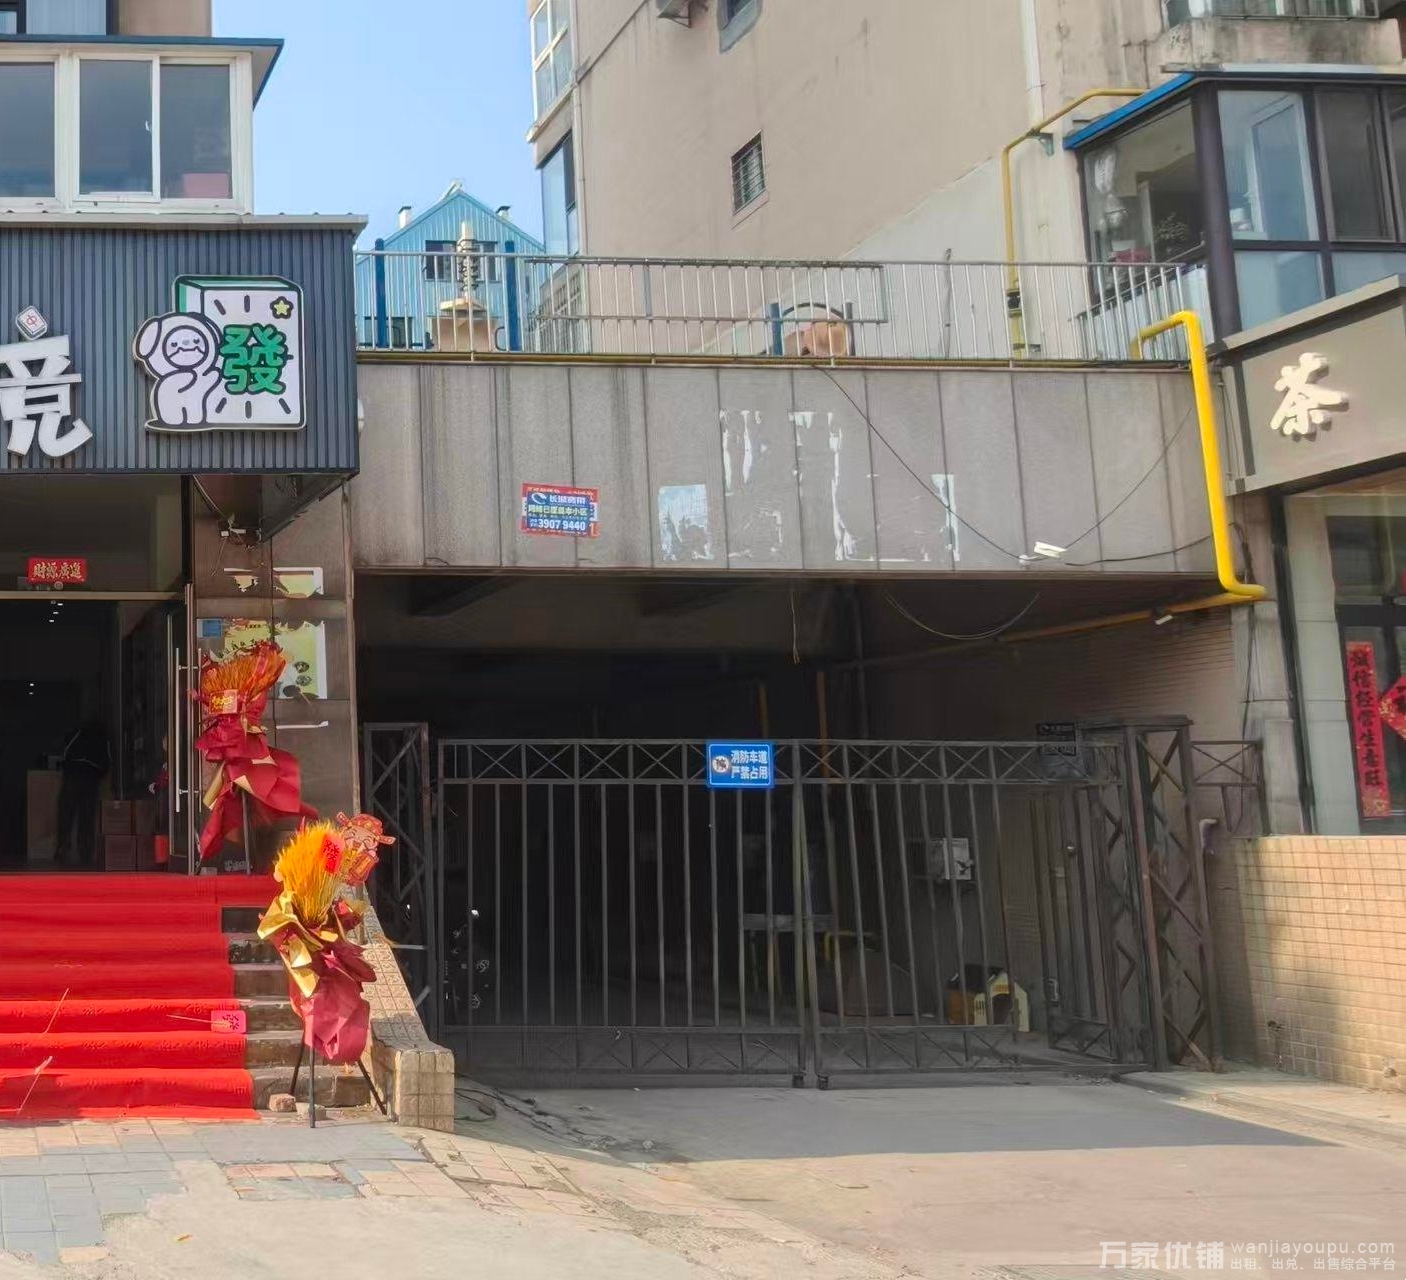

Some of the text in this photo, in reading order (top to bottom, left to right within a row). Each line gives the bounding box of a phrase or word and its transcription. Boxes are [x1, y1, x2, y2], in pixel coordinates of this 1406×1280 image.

[220, 323, 286, 397] 發
[1270, 351, 1349, 437] 茶
[538, 519, 560, 528] 3907
[563, 521, 586, 531] 9440
[731, 749, 768, 764] 消防车道
[731, 765, 768, 779] 严禁占用
